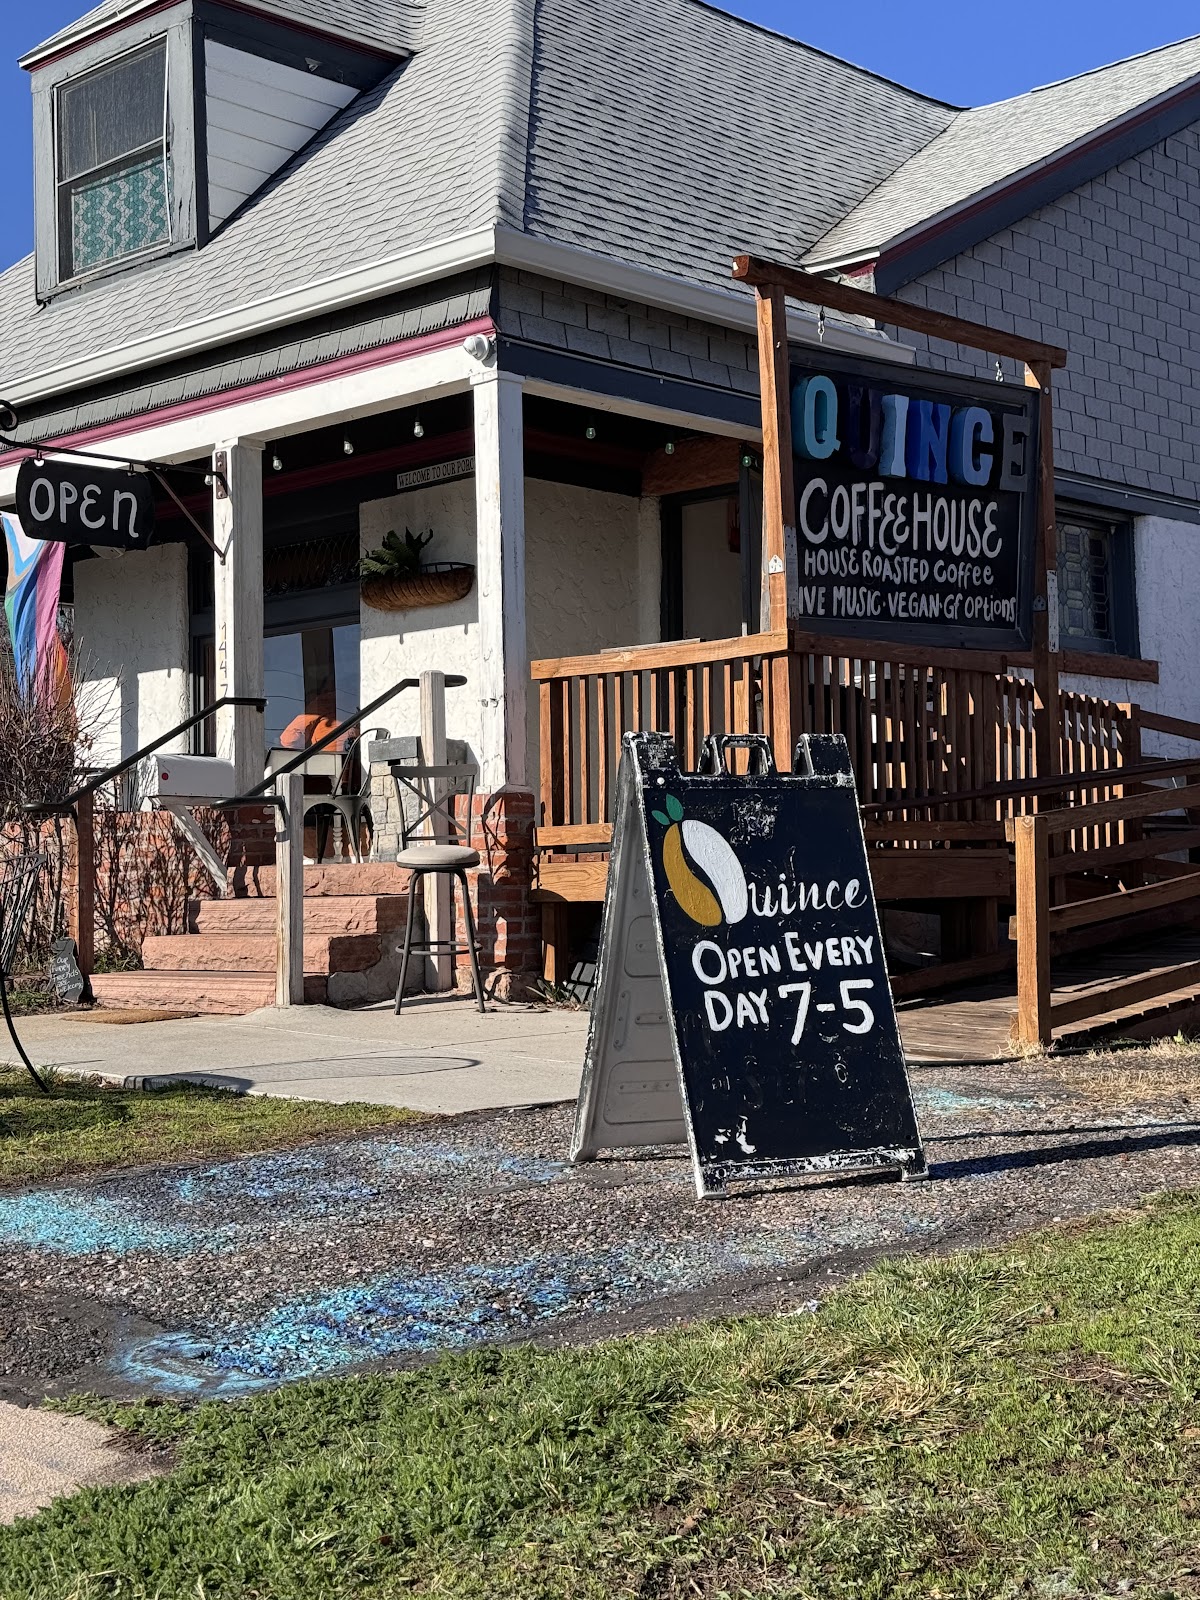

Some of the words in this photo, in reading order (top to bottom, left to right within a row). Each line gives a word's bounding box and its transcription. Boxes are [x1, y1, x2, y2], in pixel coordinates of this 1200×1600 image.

[793, 375, 1032, 493] QUINCE
[398, 468, 431, 487] WELCOME
[432, 466, 441, 480] TO
[442, 462, 456, 477] OUR
[457, 457, 475, 473] PORC
[804, 546, 860, 578] HOUSE
[862, 549, 930, 585] ROASTED
[798, 585, 826, 616] IVE
[218, 621, 229, 698] 1447
[691, 939, 782, 985] OPEN
[784, 931, 874, 972] EVERY
[703, 988, 771, 1032] DAY
[777, 978, 875, 1046] 7-5
